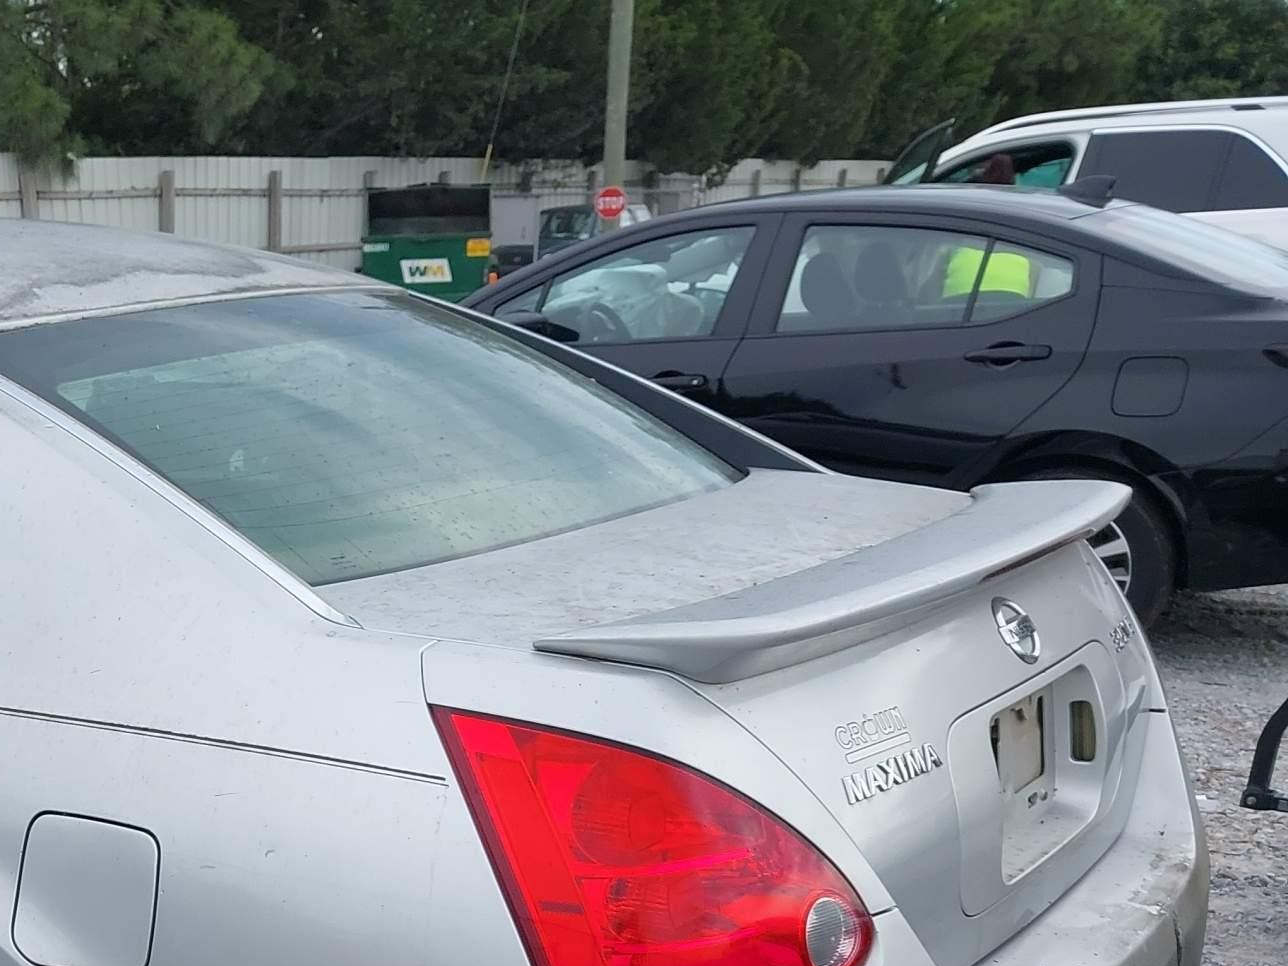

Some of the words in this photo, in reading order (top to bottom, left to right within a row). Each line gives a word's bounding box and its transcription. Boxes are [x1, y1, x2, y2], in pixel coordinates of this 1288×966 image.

[597, 195, 624, 210] STOP
[408, 265, 444, 278] WM
[841, 742, 944, 806] MAXIMA
